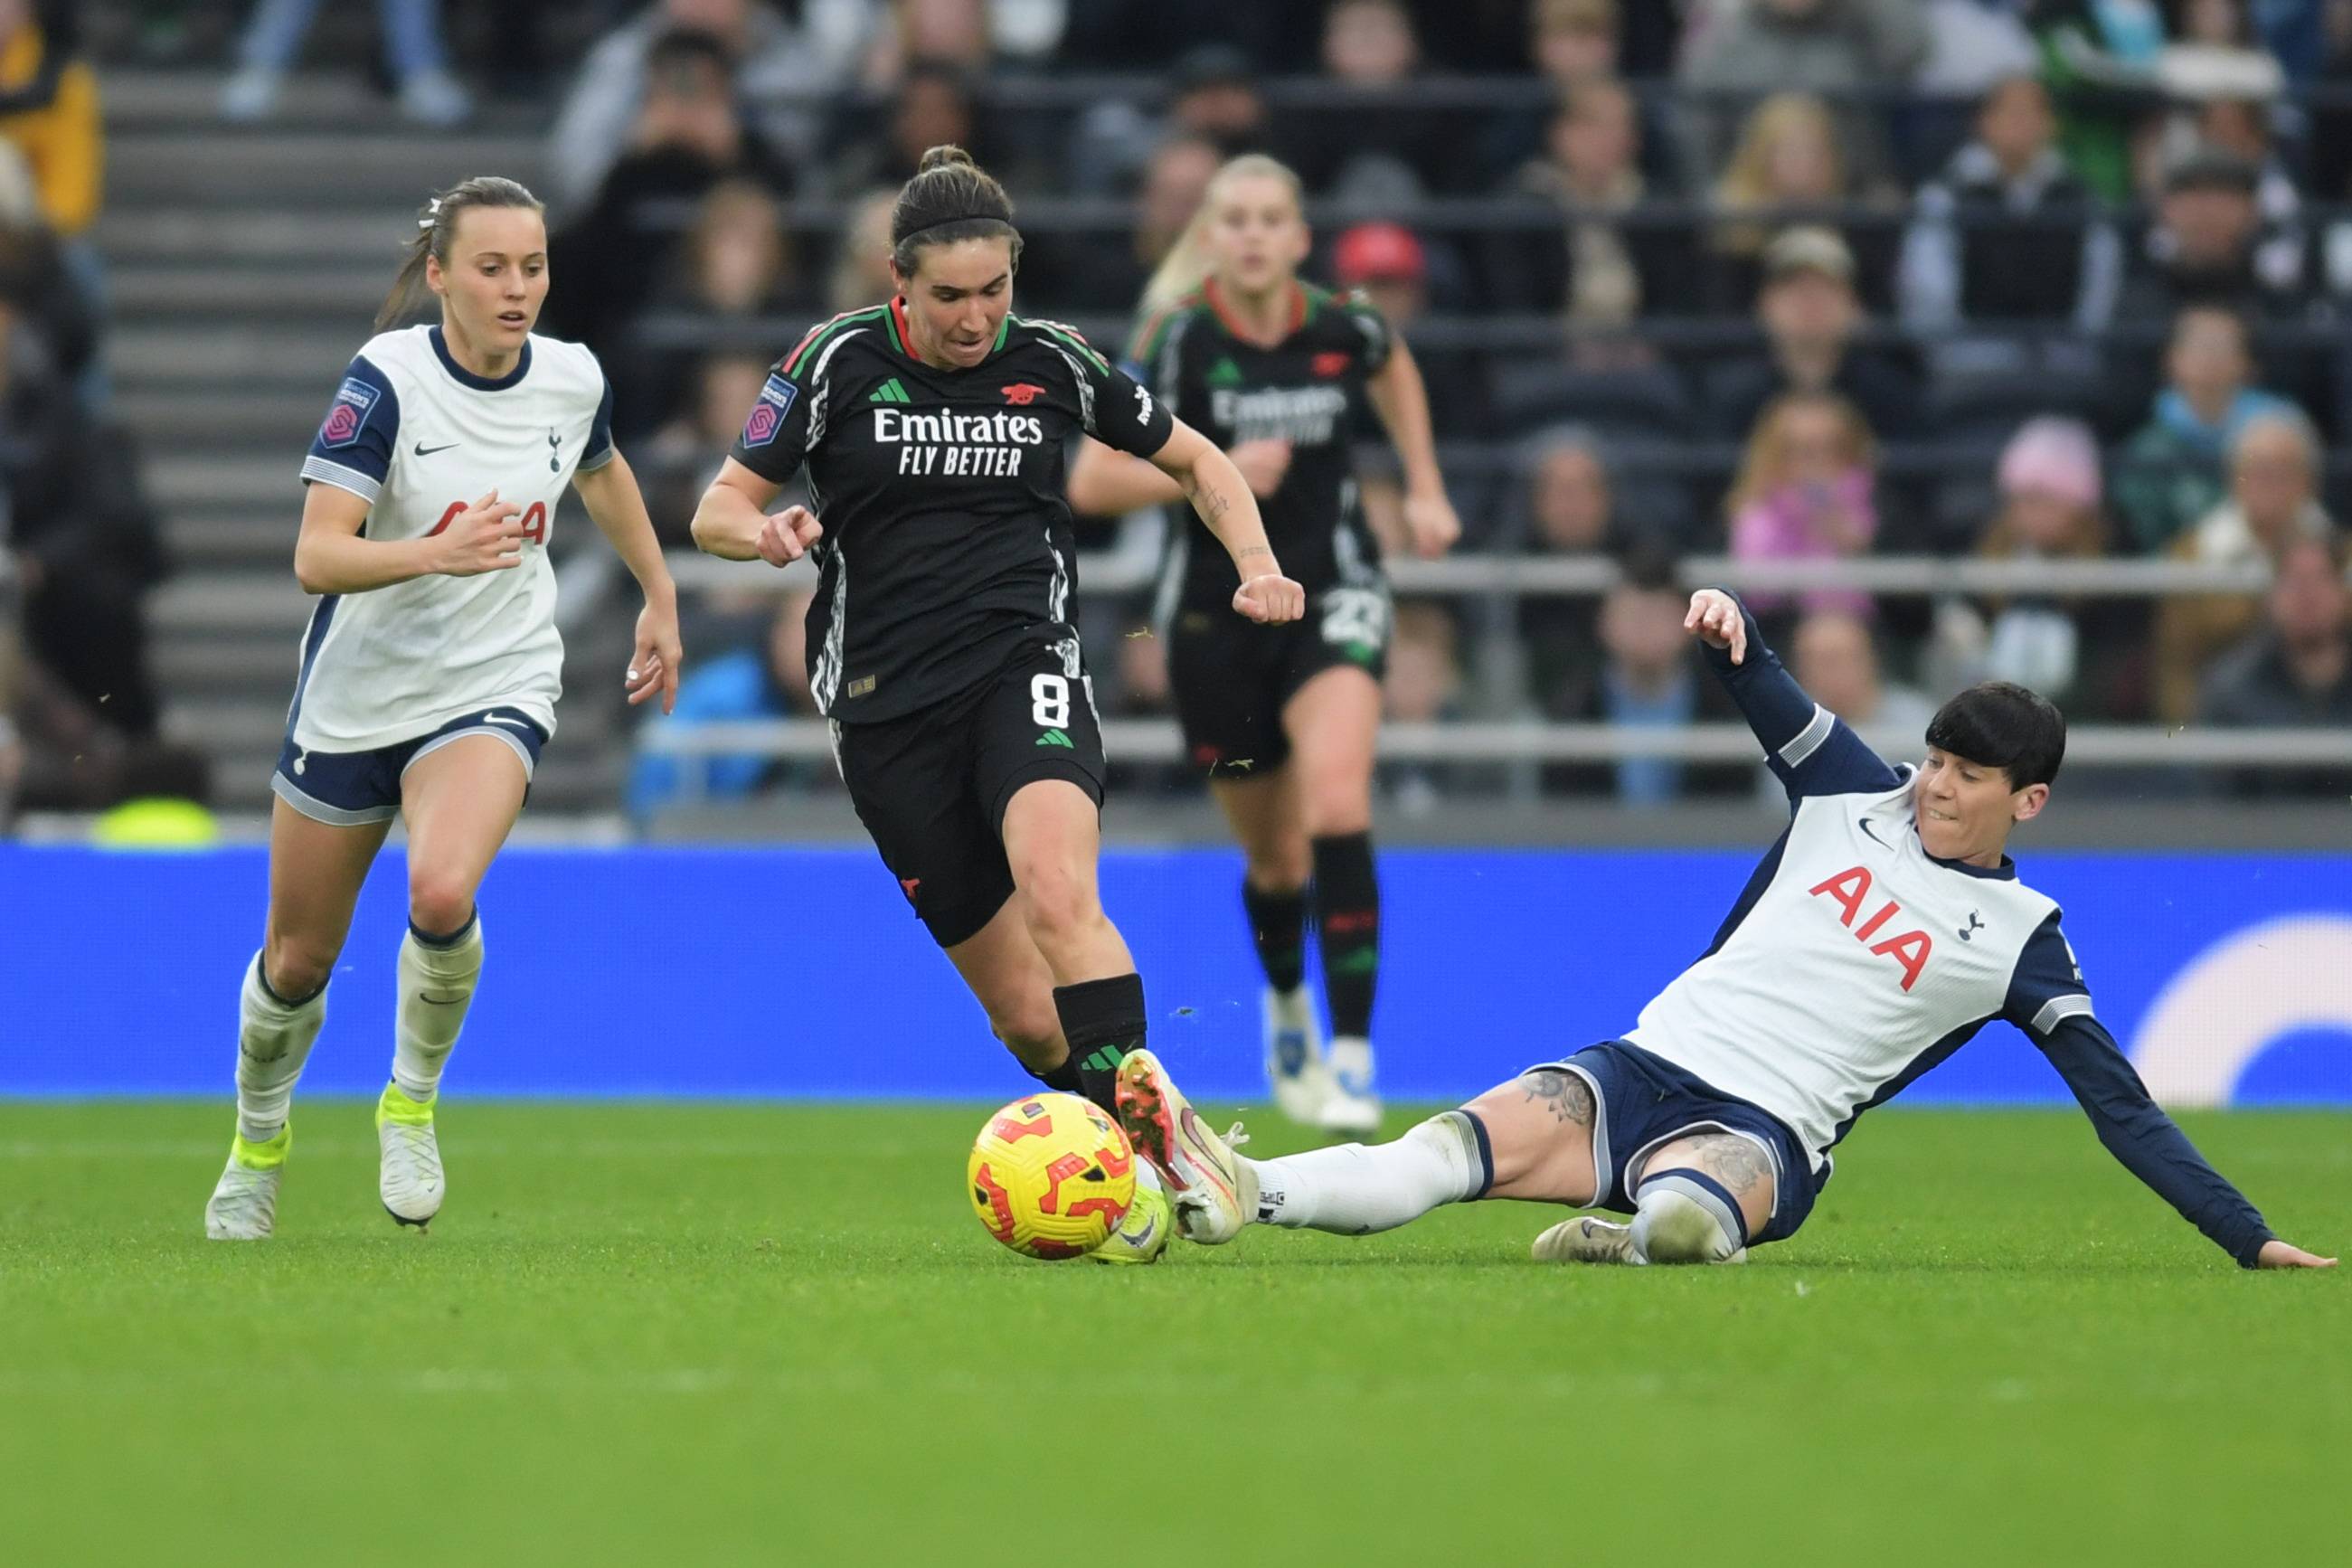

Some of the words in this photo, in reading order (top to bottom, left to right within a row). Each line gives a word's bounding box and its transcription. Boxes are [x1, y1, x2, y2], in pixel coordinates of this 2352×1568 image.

[874, 407, 1043, 445] Emirates
[899, 446, 938, 475] FLY
[943, 447, 1022, 477] BETTER
[1031, 673, 1070, 729] 8
[1808, 866, 1932, 993] AIA
